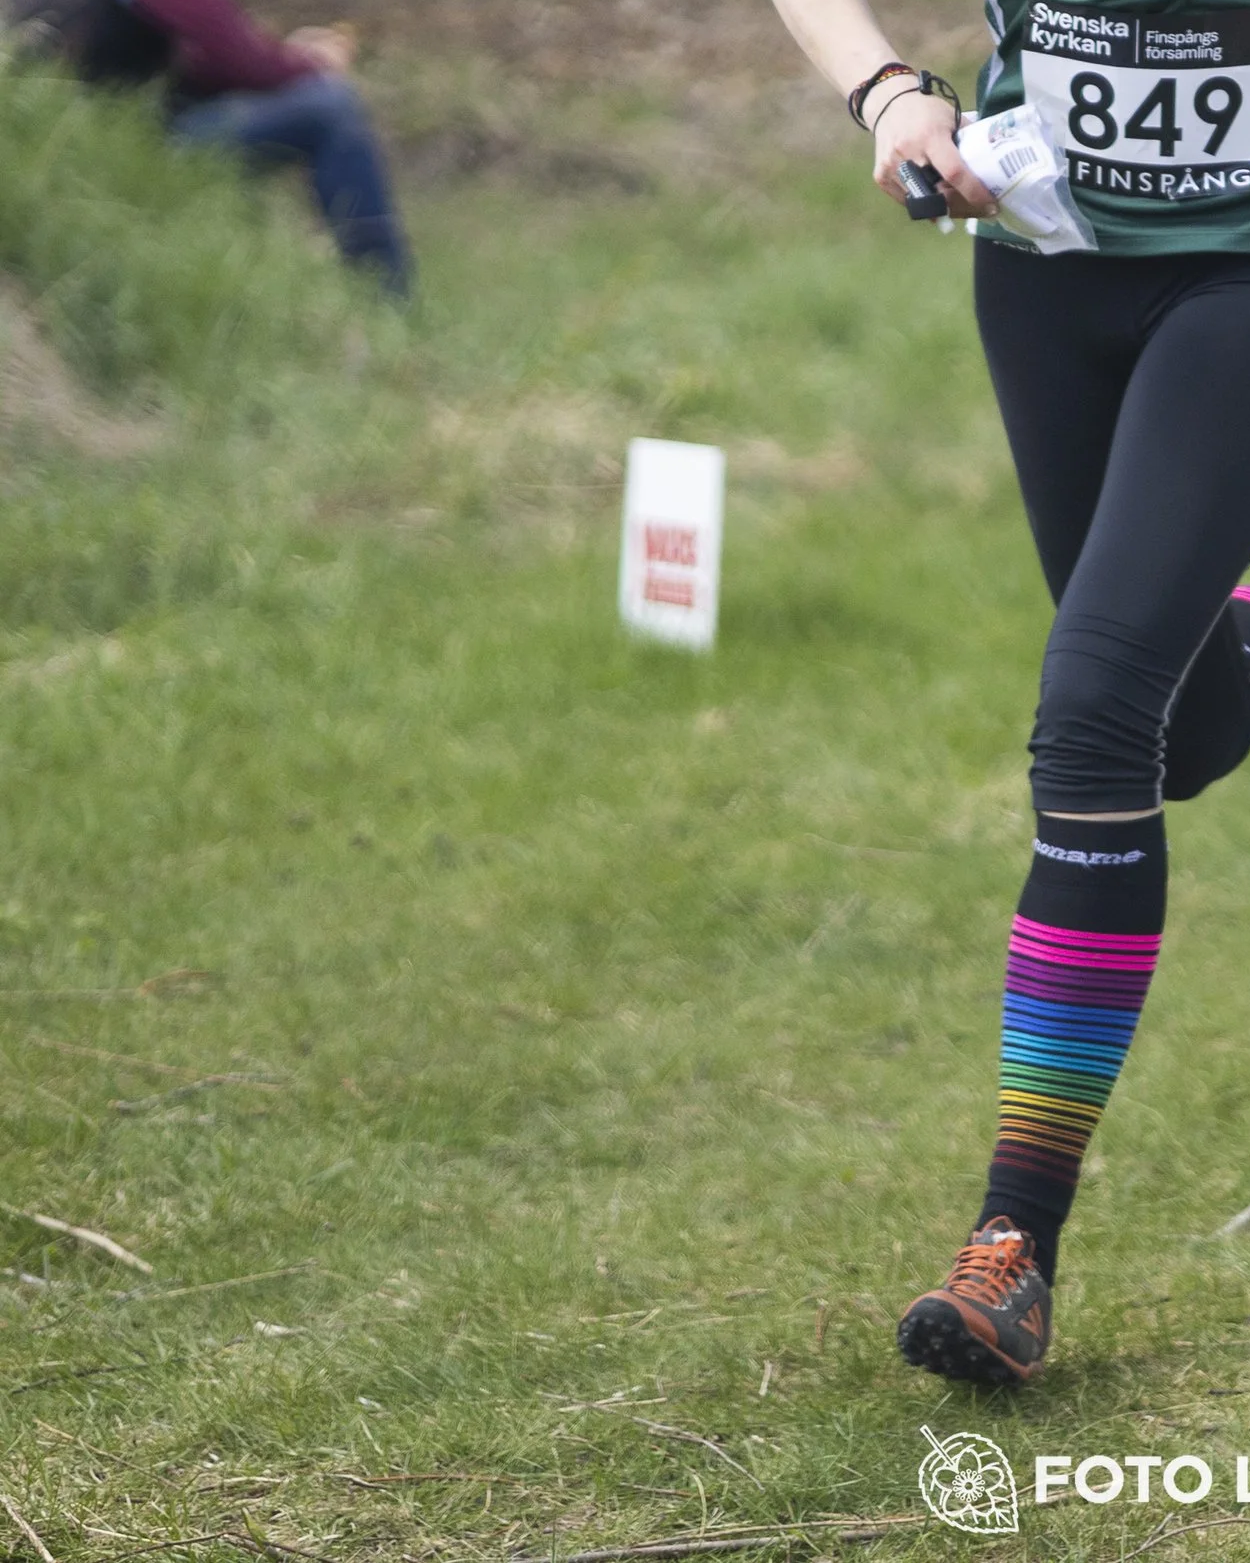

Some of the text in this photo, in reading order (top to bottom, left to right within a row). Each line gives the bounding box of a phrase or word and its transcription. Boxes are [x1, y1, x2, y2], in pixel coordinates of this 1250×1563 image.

[1032, 2, 1129, 37] Svenska
[1030, 23, 1111, 56] kyrkan
[1145, 45, 1223, 61] församling
[1146, 30, 1219, 46] Finspångs
[1068, 71, 1243, 157] 849
